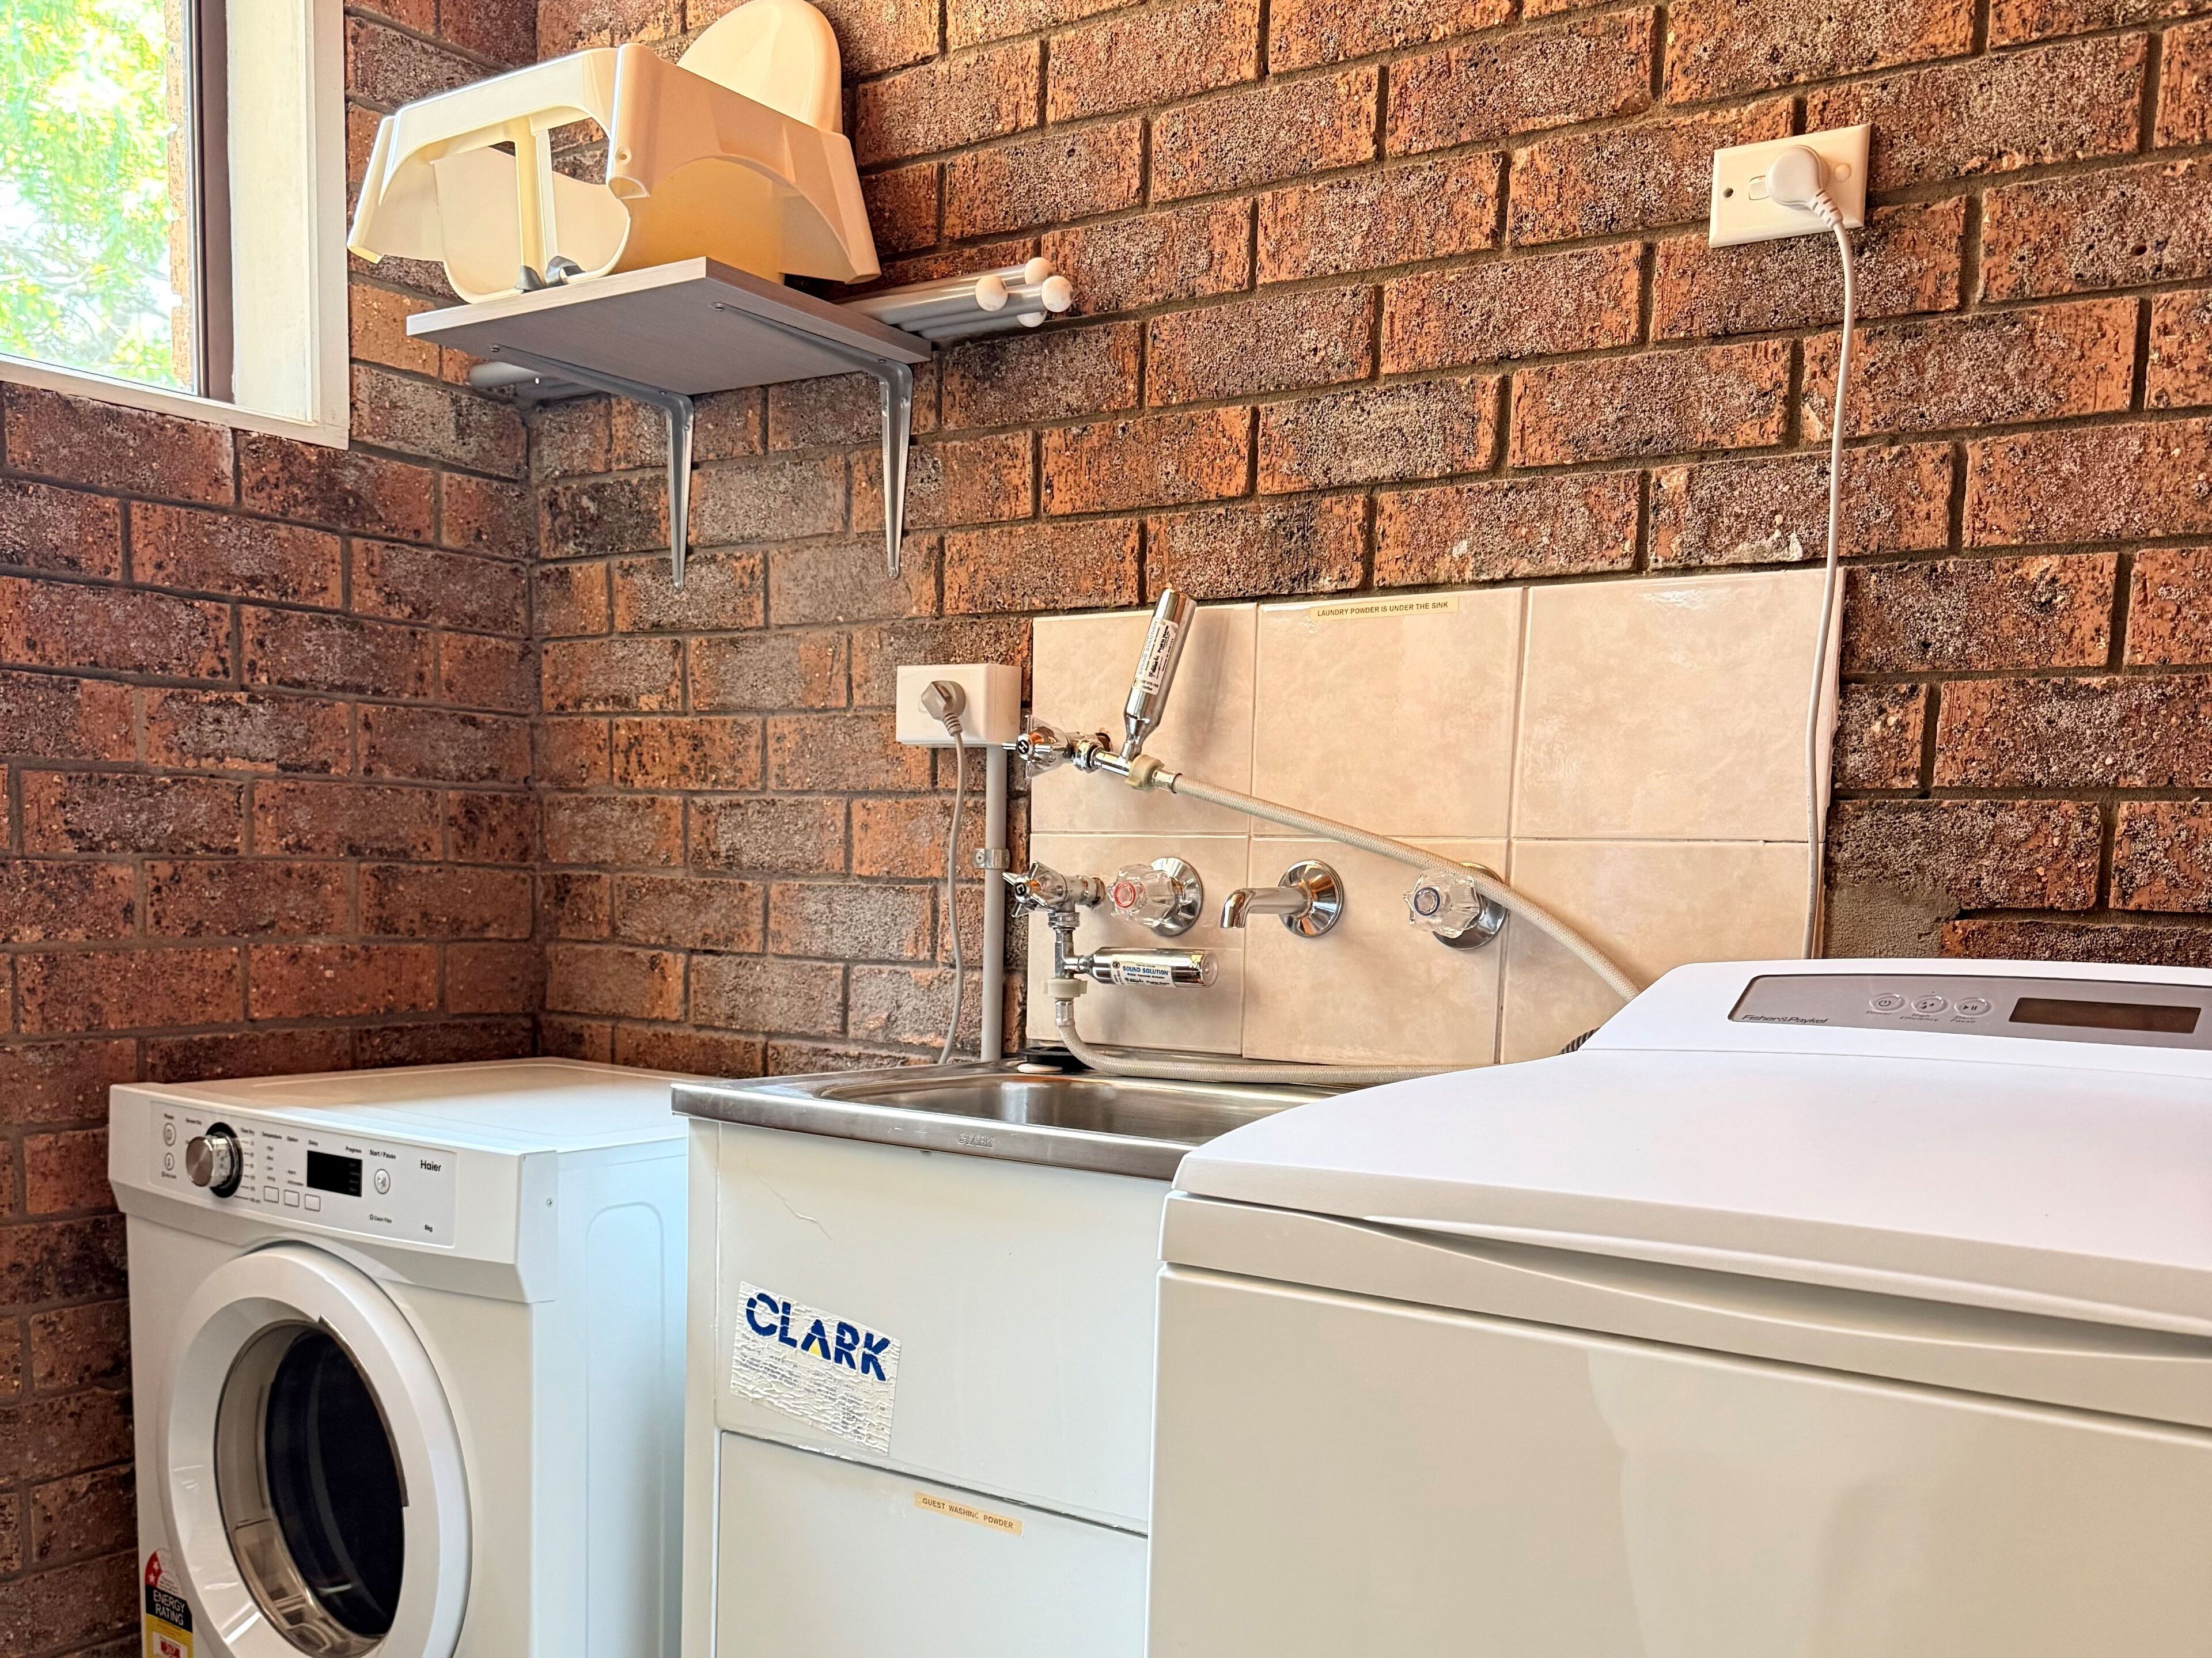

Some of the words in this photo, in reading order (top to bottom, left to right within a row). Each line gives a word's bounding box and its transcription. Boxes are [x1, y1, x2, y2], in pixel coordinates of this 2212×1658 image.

[1317, 608, 1349, 617] LAUNDRY
[1350, 606, 1379, 614] POWDER
[1018, 741, 1028, 753] H
[1016, 884, 1025, 894] C
[958, 1133, 995, 1149] CLARK
[421, 1159, 441, 1172] Haier
[745, 1292, 891, 1382] CLARK
[922, 1497, 945, 1510] GUEST
[983, 1515, 1013, 1529] POWDER
[153, 1589, 185, 1613] ENERGY
[156, 1603, 184, 1626] RATING
